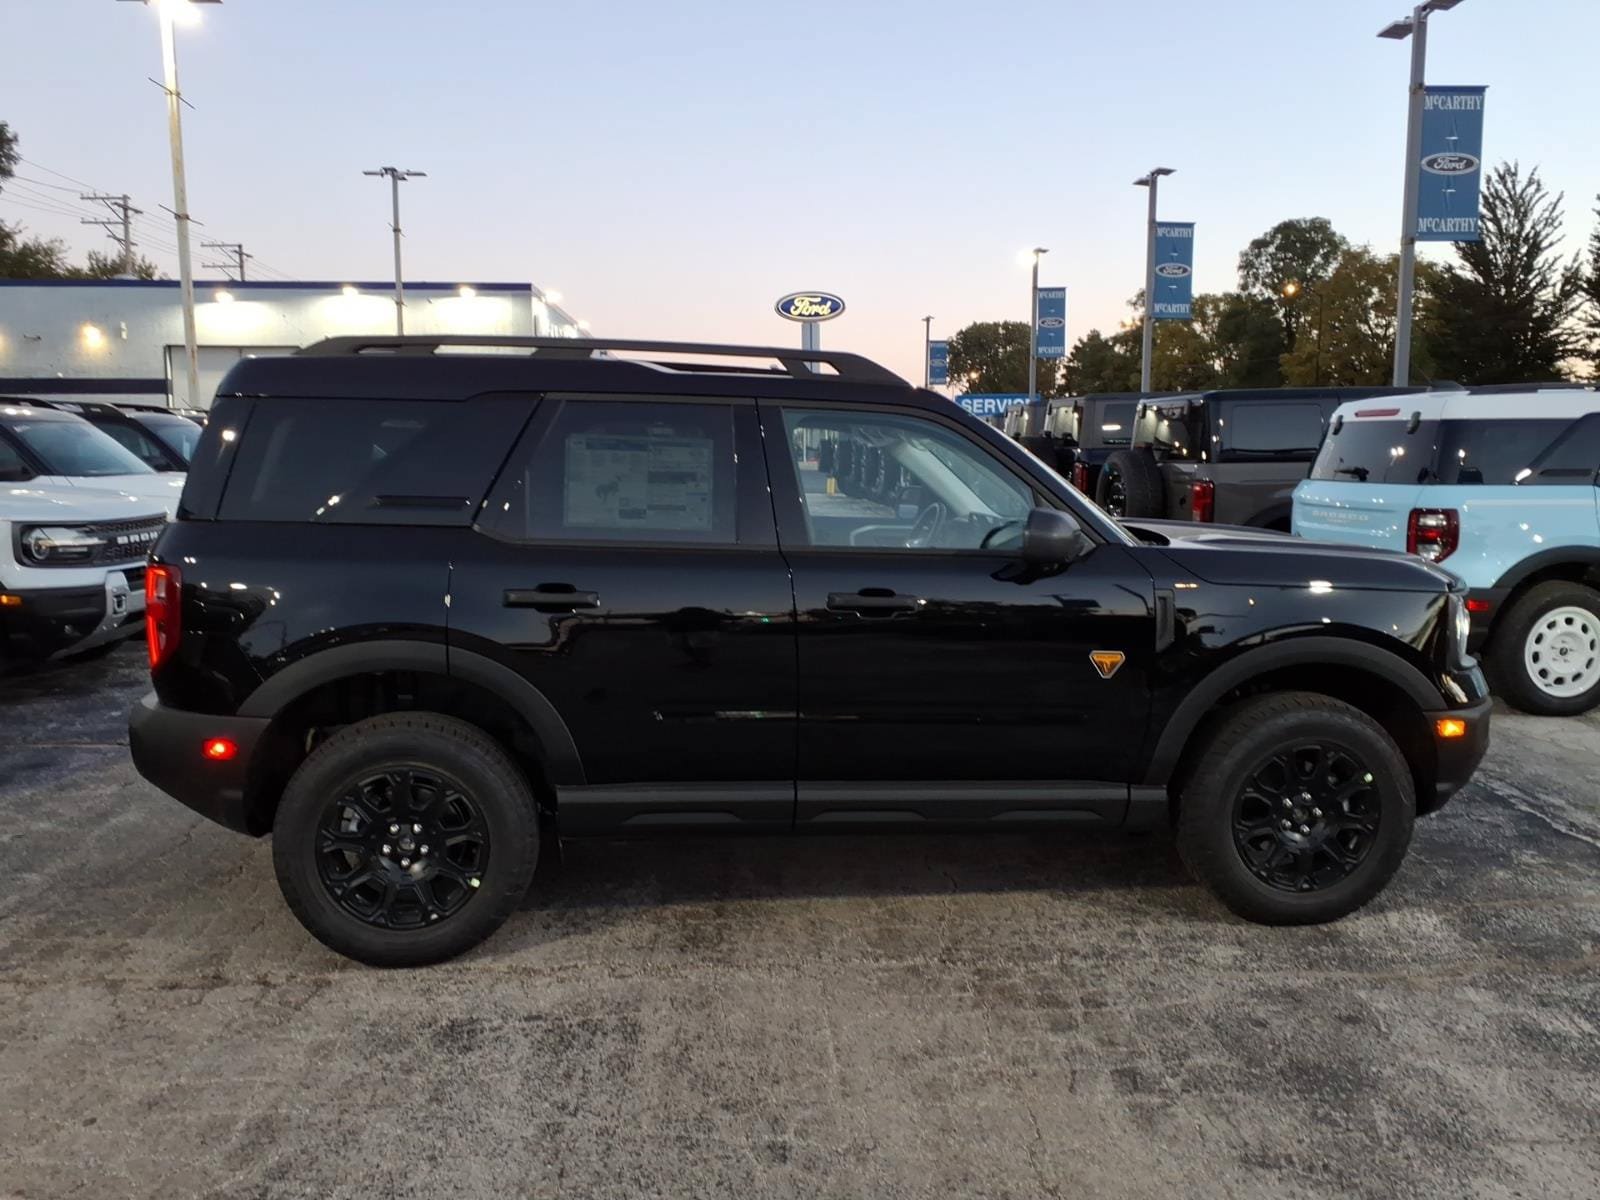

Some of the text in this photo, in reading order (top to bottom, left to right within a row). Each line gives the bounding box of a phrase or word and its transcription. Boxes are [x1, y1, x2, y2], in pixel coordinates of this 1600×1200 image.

[1433, 156, 1467, 169] Ford
[790, 297, 831, 316] Ford
[961, 399, 1030, 413] SERV
[117, 531, 159, 544] BRON
